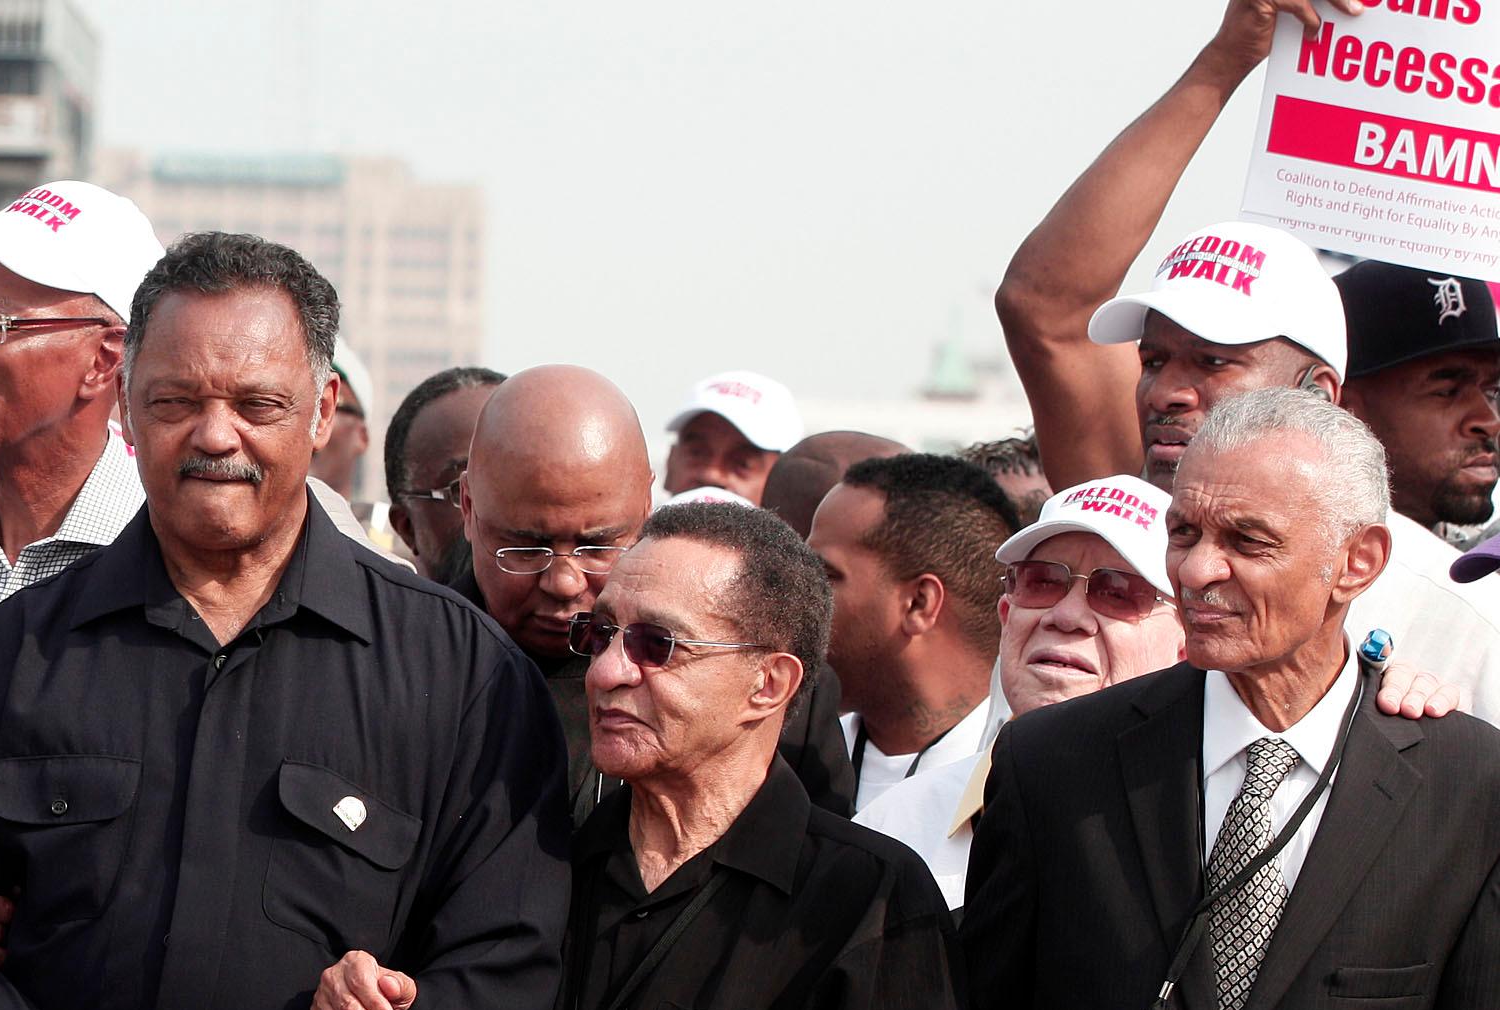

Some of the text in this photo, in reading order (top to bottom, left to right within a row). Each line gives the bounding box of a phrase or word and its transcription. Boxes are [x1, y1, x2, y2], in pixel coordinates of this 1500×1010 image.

[1354, 121, 1500, 189] BAMN
[1276, 168, 1330, 190] Coalition
[1333, 180, 1346, 193] to
[1348, 182, 1394, 201] Defend
[1396, 191, 1467, 214] Affirmative
[1286, 190, 1323, 209] Rights
[1326, 199, 1349, 213] and
[1352, 203, 1384, 222] Fight
[1386, 207, 1404, 223] for
[1407, 213, 1458, 235] Equality
[1462, 222, 1478, 239] By
[1167, 259, 1256, 297] WALK
[1064, 487, 1158, 520] FREEDOM
[1081, 500, 1151, 531] WALK
